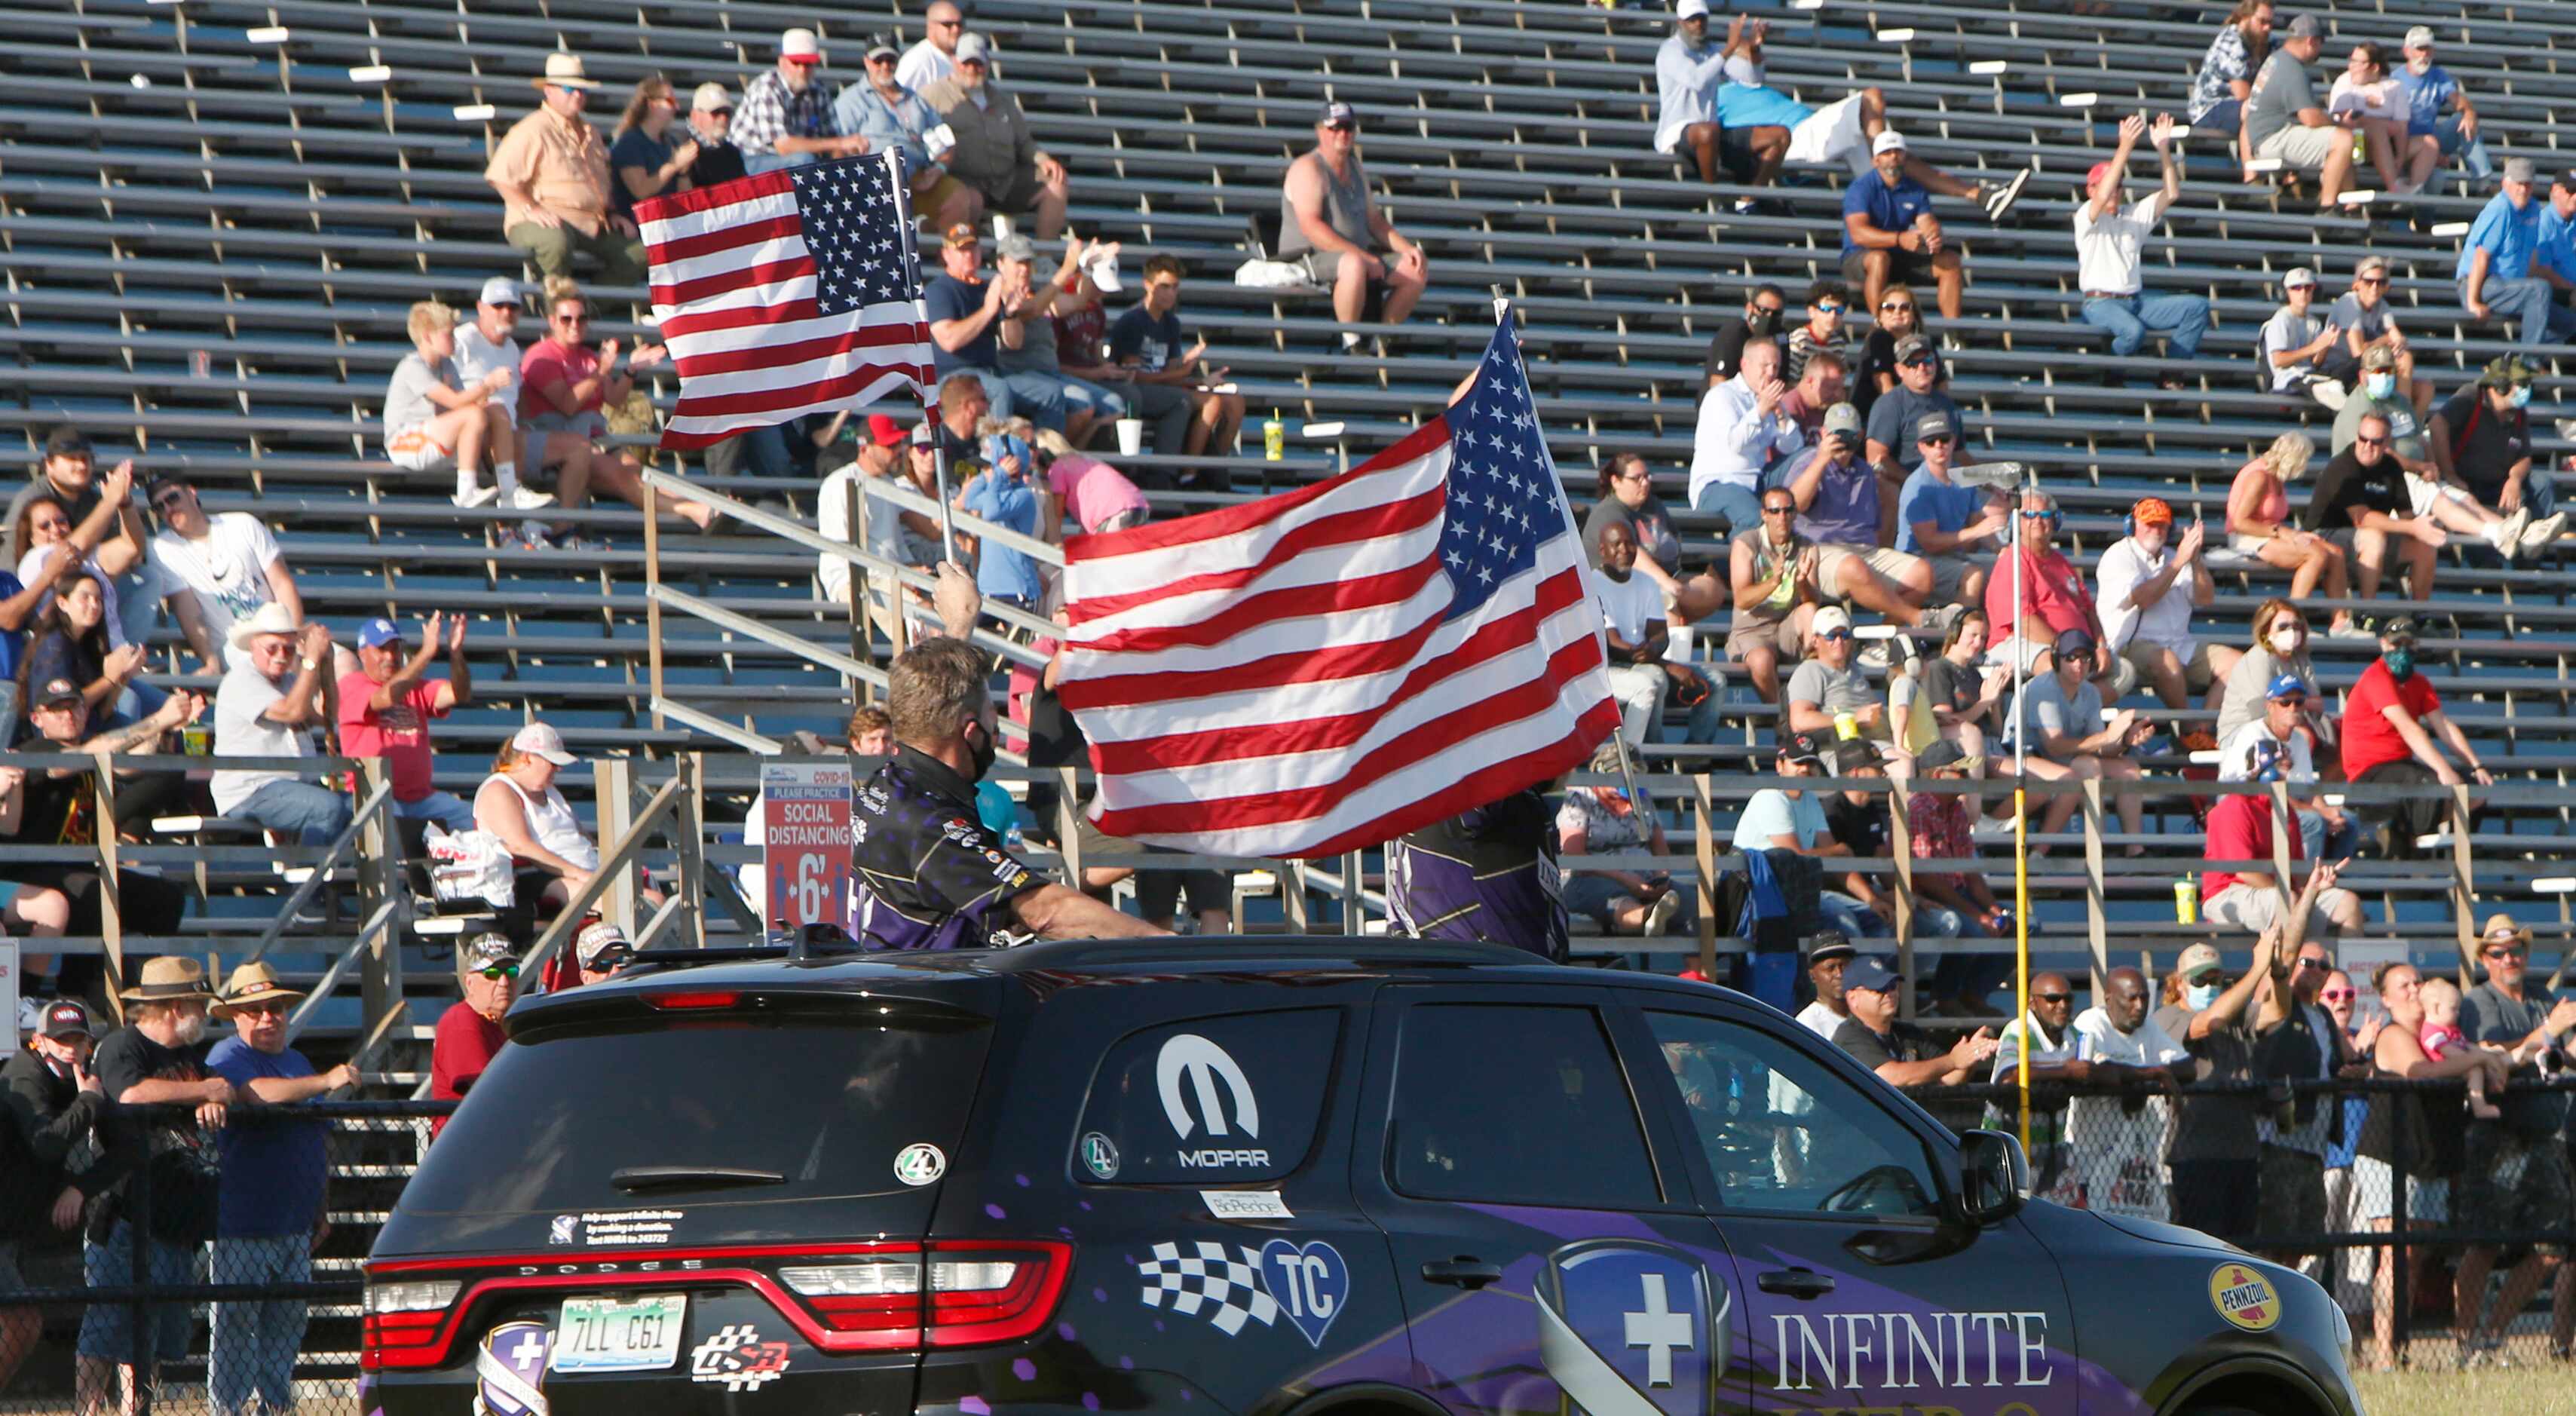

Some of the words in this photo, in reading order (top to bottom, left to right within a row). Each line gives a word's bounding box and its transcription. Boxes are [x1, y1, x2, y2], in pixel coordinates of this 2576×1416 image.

[774, 788, 804, 798] PLEASE
[804, 788, 841, 798] PRACTICE
[784, 804, 833, 823] SOCIAL
[769, 826, 850, 844] DISTANCING
[1178, 1149, 1272, 1168] MOPAR
[581, 1212, 601, 1223] Help
[601, 1212, 633, 1222] support
[633, 1209, 662, 1221] Infinite
[662, 1209, 683, 1220] Hero
[586, 1224, 597, 1235] by
[597, 1223, 627, 1234] making
[586, 1236, 603, 1245] Text
[603, 1234, 627, 1244] NHRA
[627, 1235, 638, 1244] to
[519, 1259, 703, 1276] DODGE
[1276, 1254, 1334, 1319] TC
[2220, 1281, 2270, 1311] PENNZOIL
[573, 1316, 611, 1353] 7LL
[626, 1314, 665, 1350] C61
[1770, 1311, 2053, 1391] INFINITE
